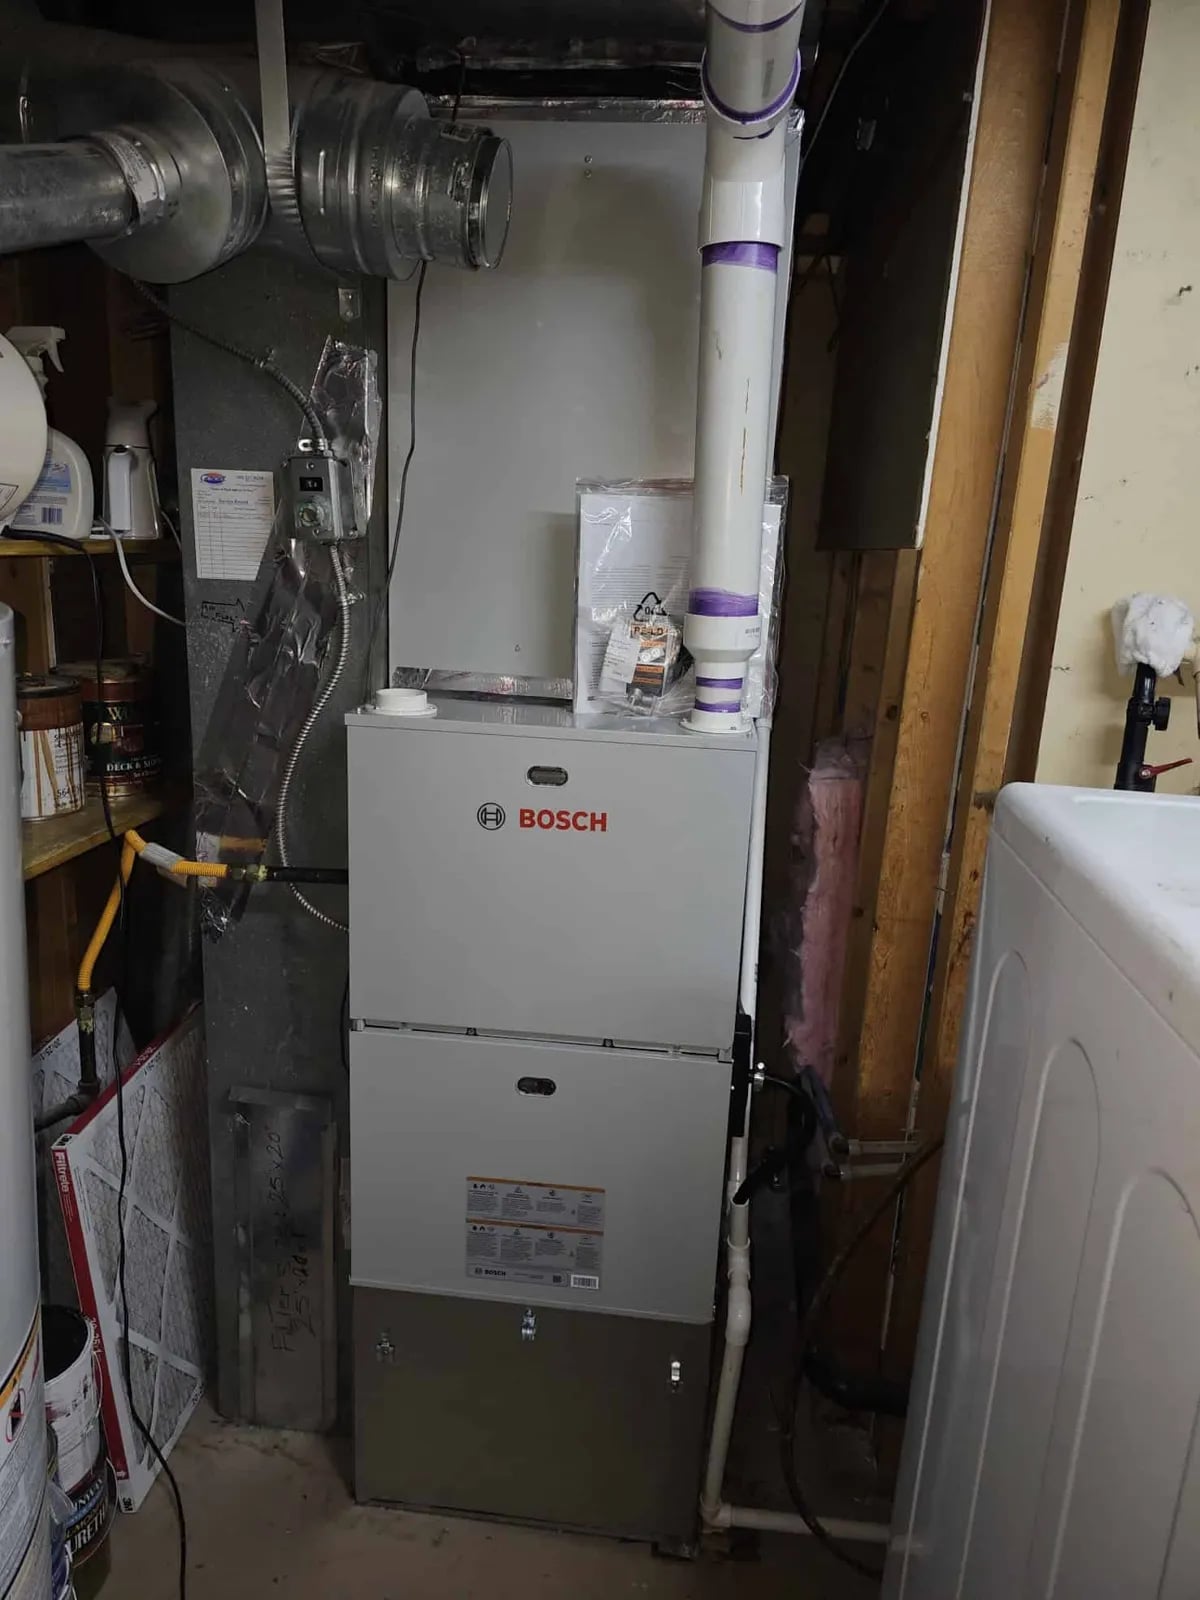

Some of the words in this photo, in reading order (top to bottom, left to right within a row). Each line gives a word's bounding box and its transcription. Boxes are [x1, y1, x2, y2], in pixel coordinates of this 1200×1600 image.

[106, 761, 133, 772] DECK
[519, 808, 608, 832] BOSCH
[54, 1151, 71, 1193] Filtrete
[484, 1269, 507, 1278] BOSCH
[122, 1497, 134, 1512] 3M
